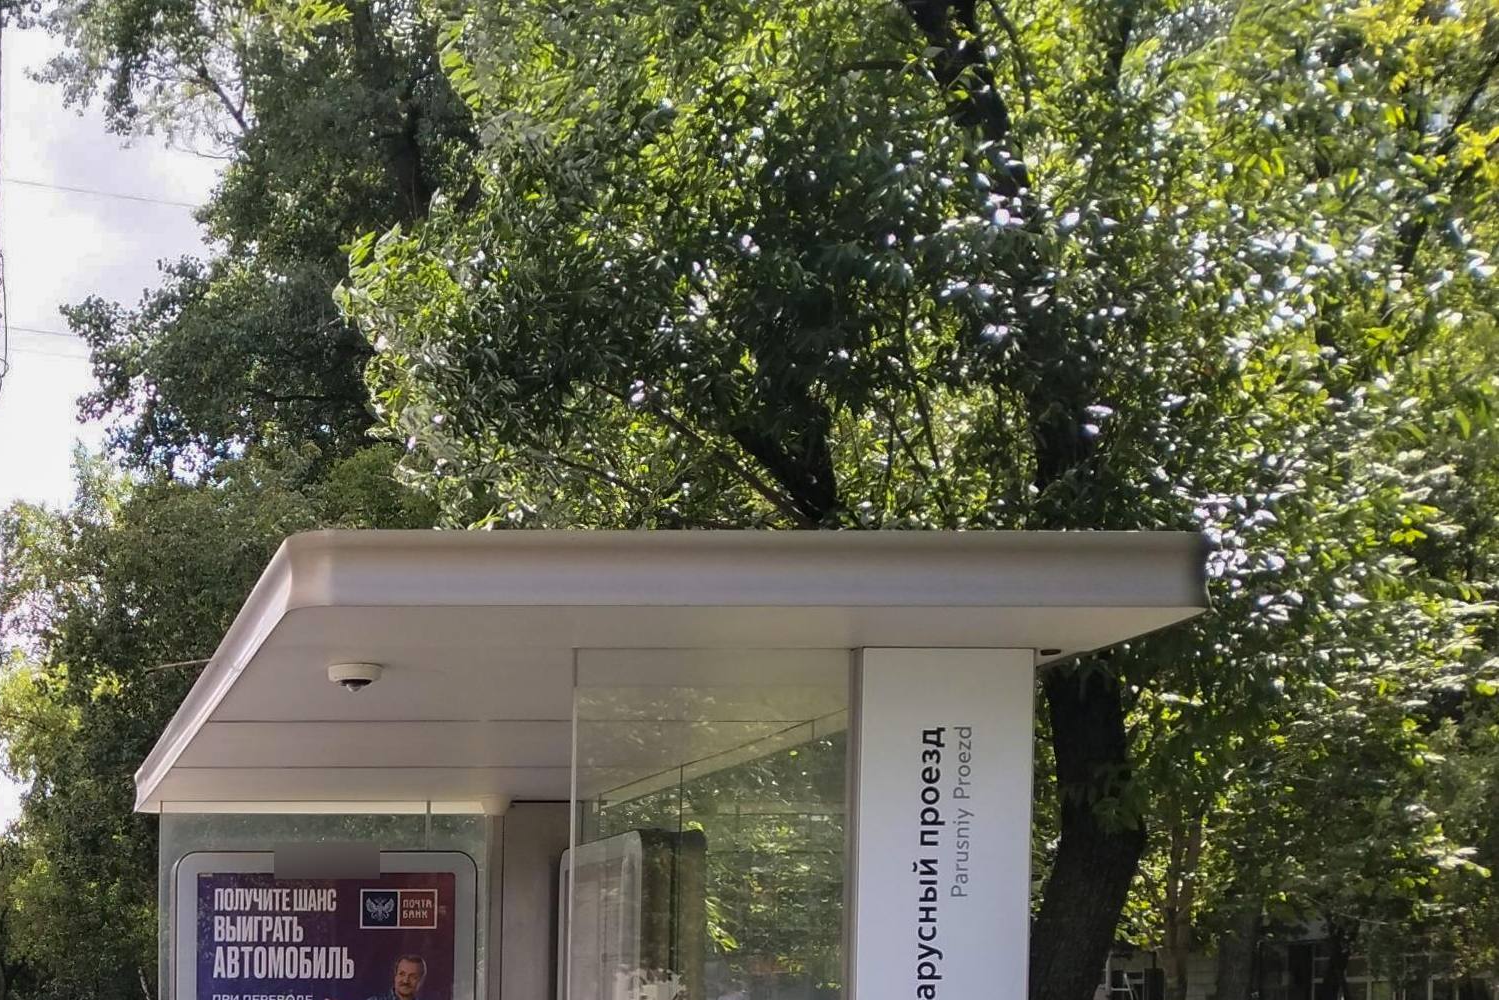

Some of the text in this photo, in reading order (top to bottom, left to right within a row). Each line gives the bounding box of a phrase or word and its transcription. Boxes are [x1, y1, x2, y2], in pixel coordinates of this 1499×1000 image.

[919, 727, 946, 847] проезд
[951, 726, 974, 898] Parusniy Proezd
[214, 888, 336, 912] ПОЛУЧИТЕ ШАНС
[403, 899, 433, 908] ПОЧТА
[403, 910, 428, 919] БАНК
[214, 916, 303, 943] ВЫИГРАТЬ
[213, 947, 354, 979] АВТОМОБИЛЬ
